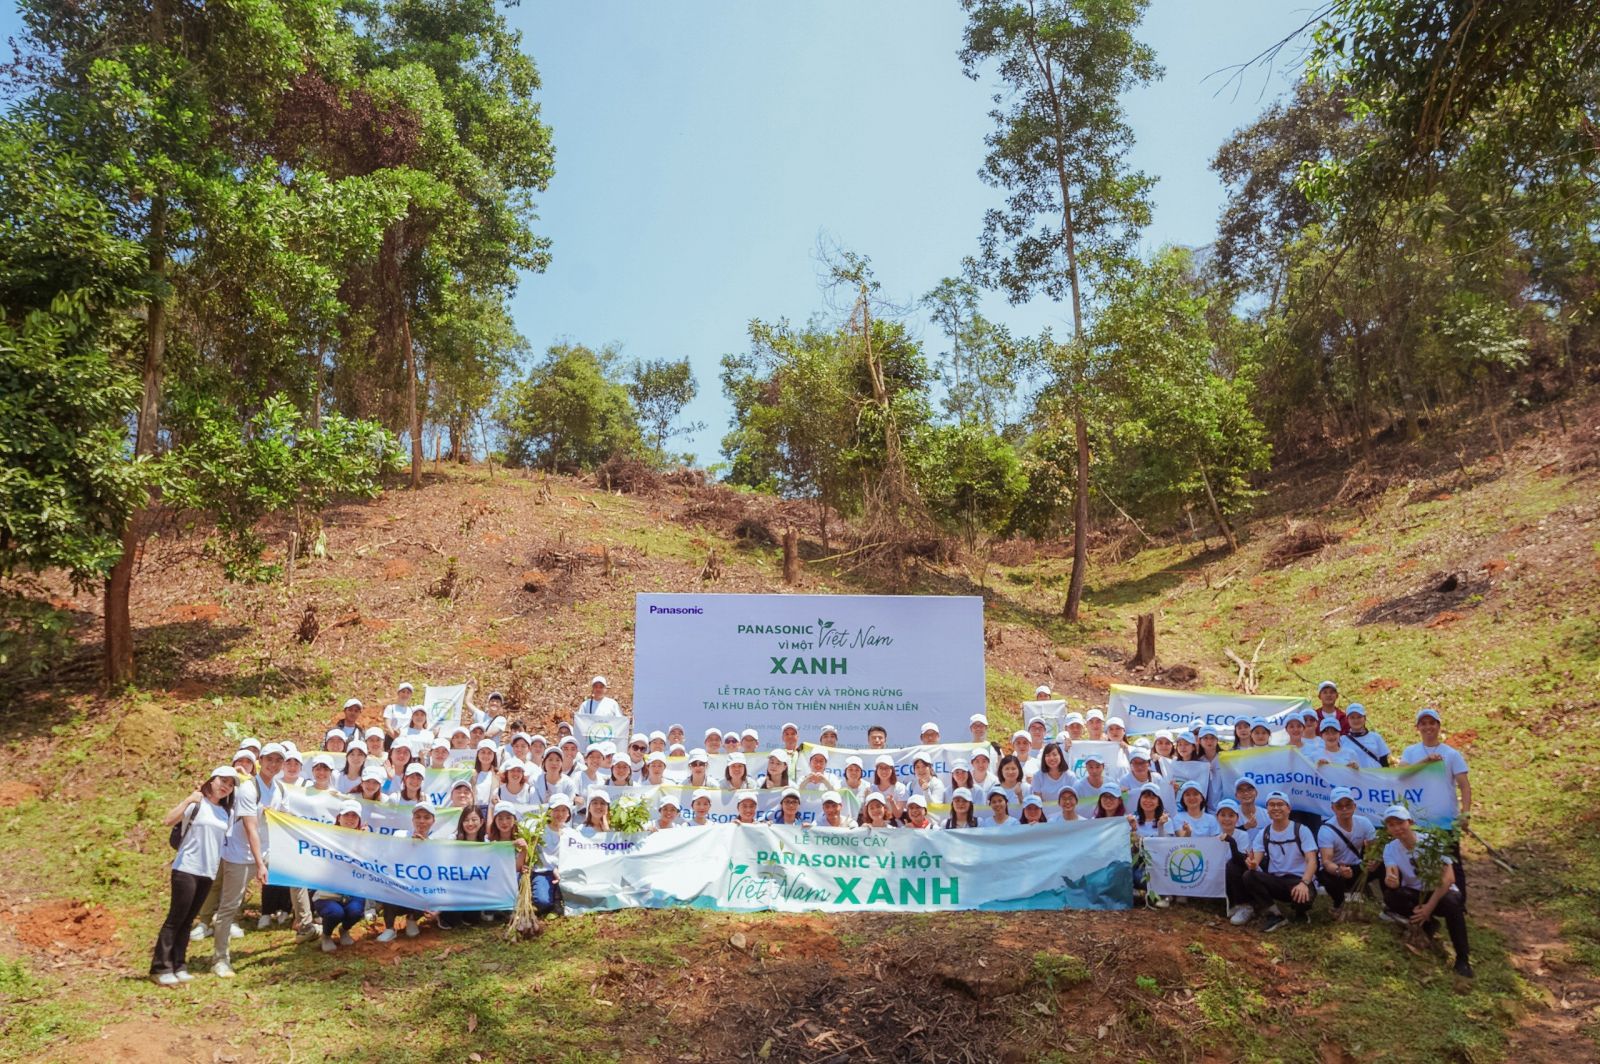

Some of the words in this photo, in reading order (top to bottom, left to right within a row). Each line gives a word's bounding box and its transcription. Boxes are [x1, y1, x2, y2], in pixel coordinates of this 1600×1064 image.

[650, 606, 704, 614] Panasonic
[737, 624, 814, 634] PANASONIC
[818, 625, 850, 649] Việt
[850, 625, 894, 649] Nam
[778, 640, 790, 650] VÌ
[791, 640, 814, 651] MỘT
[770, 656, 848, 674] XANH
[718, 685, 730, 696] LỄ
[732, 688, 760, 696] TRAO
[762, 686, 792, 698] TẶNG
[794, 686, 814, 696] CÂY
[817, 686, 831, 696] VÀ
[834, 686, 870, 696] TRỒNG
[702, 701, 719, 714] TẠI
[722, 702, 744, 710] KHU
[747, 699, 768, 710] BẢO
[772, 700, 793, 710] TỒN
[796, 700, 826, 711] THIÊN
[830, 700, 861, 711] NHIÊN
[864, 700, 894, 711] XUÂN
[896, 700, 918, 712] LIÊN
[794, 830, 808, 844] LỄ
[863, 834, 888, 848] CÂY
[756, 851, 870, 868] PANASONIC
[876, 851, 896, 868] VÌ
[902, 850, 943, 872] MỘT
[394, 864, 432, 880] ECO
[438, 865, 491, 881] RELAY
[352, 869, 366, 879] for
[423, 886, 446, 894] Earth
[772, 872, 831, 902] Nam
[834, 876, 959, 905] XANH
